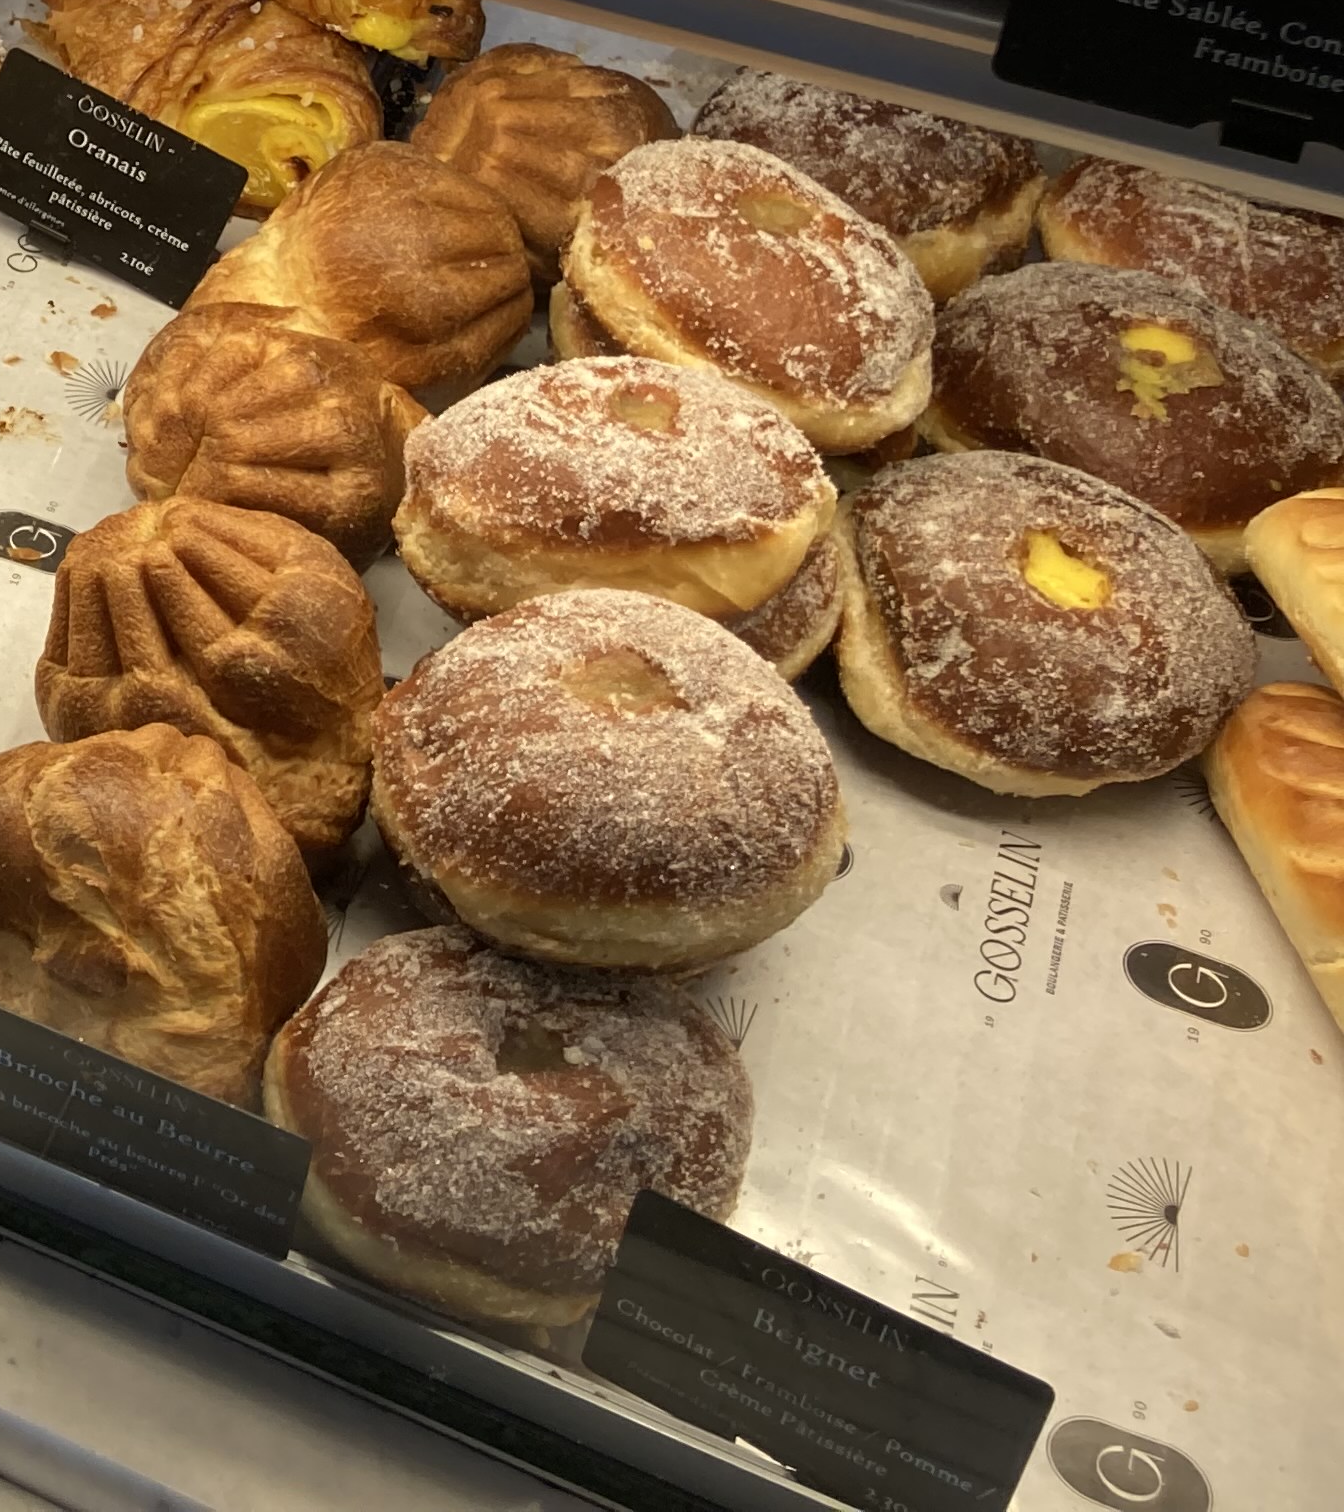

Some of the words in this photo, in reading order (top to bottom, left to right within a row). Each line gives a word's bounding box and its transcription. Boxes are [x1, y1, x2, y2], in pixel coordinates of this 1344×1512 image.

[1193, 37, 1344, 93] Framboise
[1279, 22, 1344, 56] Con
[78, 96, 166, 153] GOSSELIN
[68, 128, 148, 184] Oranais
[22, 151, 86, 197] feuilletée,
[88, 190, 145, 230] abricots,
[147, 223, 190, 253] crème
[48, 191, 113, 232] pâtissière
[973, 830, 1042, 1004] GOSSELIN
[1045, 935, 1065, 996] BOULANGERIE
[1057, 881, 1074, 928] PATISSERIE
[1198, 928, 1212, 946] 90
[1167, 963, 1230, 1008] G
[1184, 1026, 1200, 1045] 19
[96, 1135, 120, 1154] au
[112, 1104, 144, 1127] au
[155, 1118, 256, 1174] Beurre
[761, 1267, 908, 1353] GOSSELIN
[752, 1306, 883, 1390] Beignet
[617, 1297, 714, 1361] Chocolat
[740, 1363, 858, 1434] Framboise
[884, 1438, 973, 1493] Pomme
[698, 1369, 773, 1417] Crème
[779, 1410, 888, 1477] Pâtissière
[1095, 1445, 1167, 1502] G
